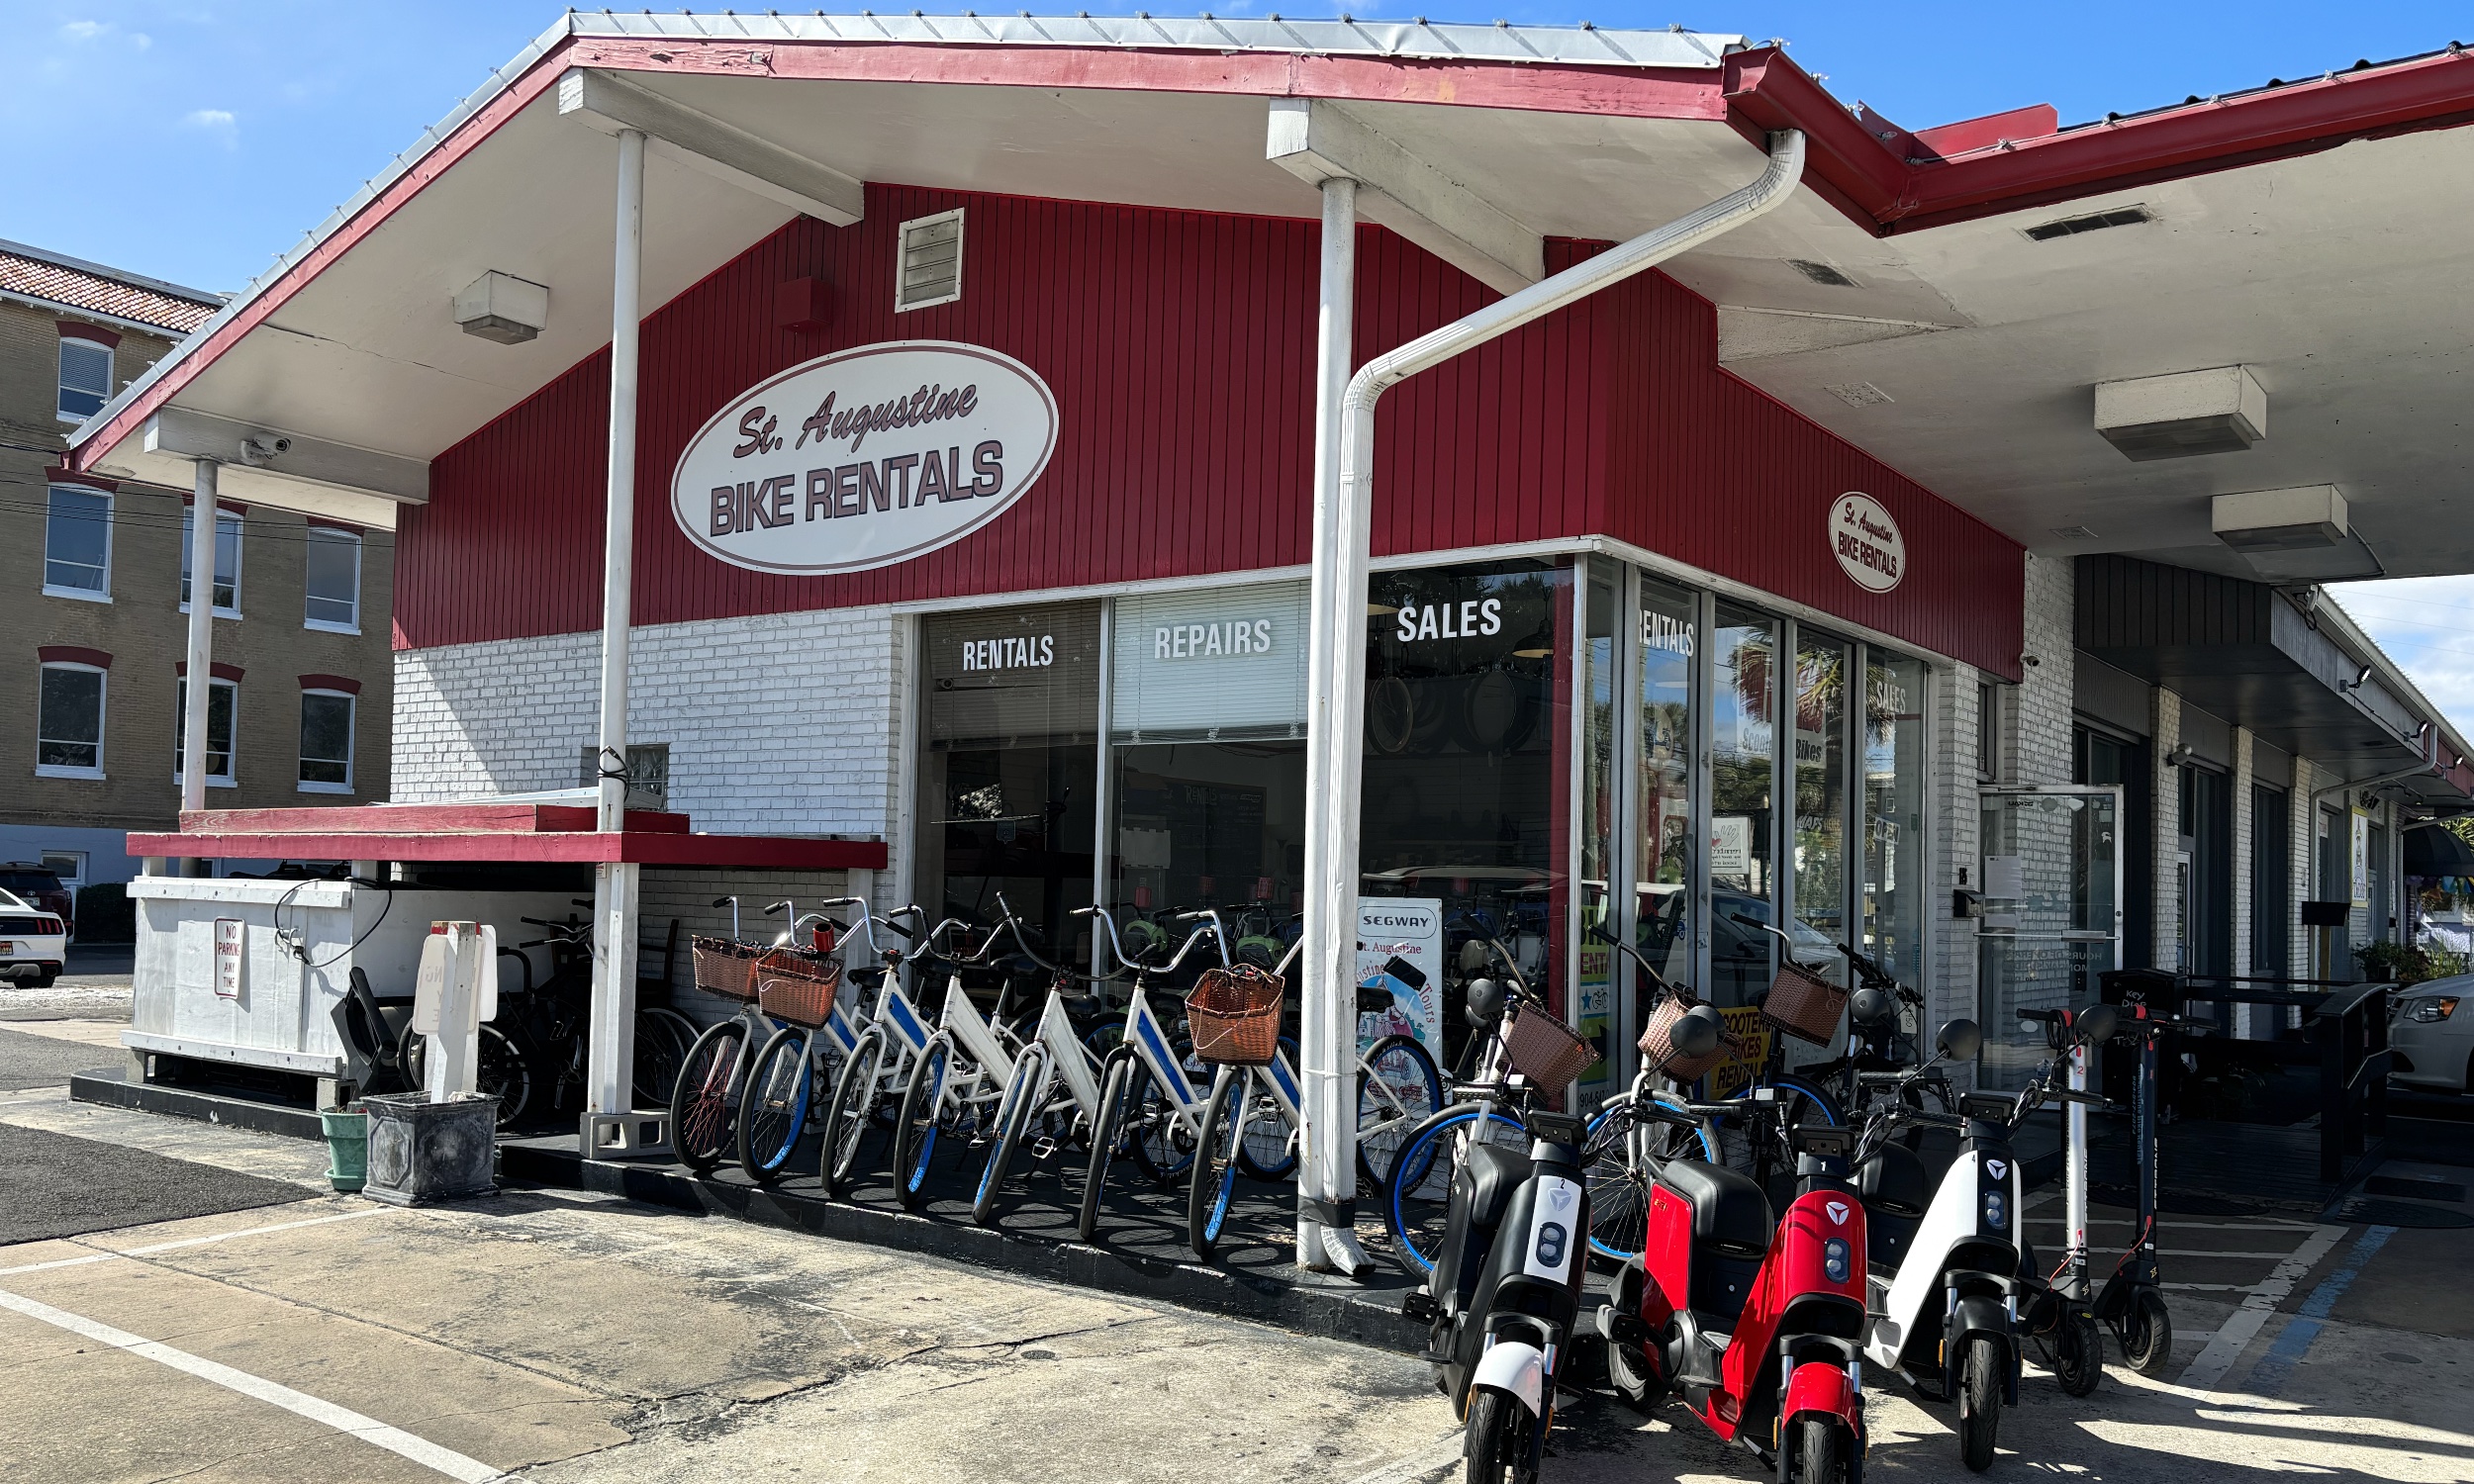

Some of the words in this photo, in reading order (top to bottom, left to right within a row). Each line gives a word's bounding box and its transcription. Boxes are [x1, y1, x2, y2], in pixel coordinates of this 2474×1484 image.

[733, 406, 783, 458] St.
[796, 383, 978, 453] Augustine
[710, 473, 795, 537] BIKE
[806, 439, 1003, 522] RENTALS
[1844, 502, 1856, 526] St.
[1857, 510, 1893, 544] Augustine
[1838, 530, 1859, 562] BIKE
[1859, 540, 1897, 579] RENTALS
[1396, 598, 1501, 642] SALES
[1155, 618, 1272, 659] REPAIRS
[963, 635, 1054, 672] RENTALS
[1876, 681, 1906, 715] SALES
[1795, 738, 1822, 763] Bikes
[1873, 819, 1900, 843] OPEN
[226, 925, 237, 939] NO
[1363, 915, 1429, 927] SEGWAY
[218, 942, 239, 957] PARKING
[1372, 941, 1422, 955] Augustine
[224, 962, 236, 974] ANY
[223, 976, 235, 988] TIME
[1419, 982, 1435, 1024] Tours
[2126, 989, 2145, 1001] Key
[2076, 1065, 2084, 1075] 2
[1820, 1160, 1827, 1171] 1
[1560, 1178, 1566, 1189] 2
